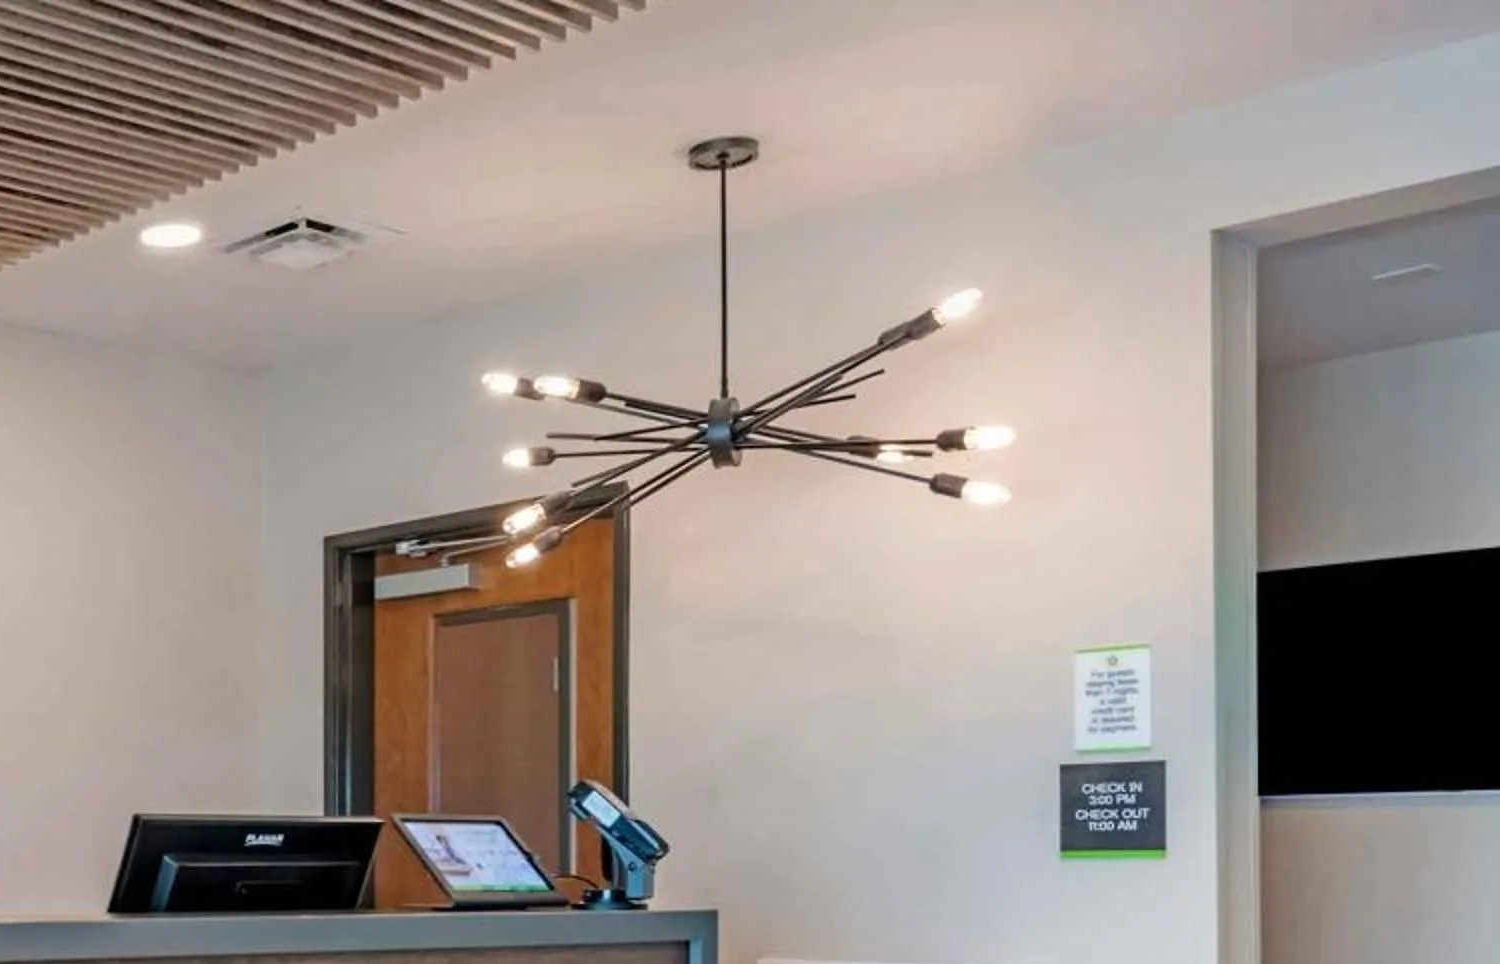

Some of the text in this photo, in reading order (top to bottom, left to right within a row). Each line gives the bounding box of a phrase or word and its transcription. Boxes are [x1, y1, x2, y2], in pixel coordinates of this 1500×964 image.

[1081, 781, 1143, 794] CHECK IN
[1088, 793, 1136, 806] 3:00 PM
[1075, 807, 1151, 821] CHECK OUT
[1088, 820, 1137, 831] 11:00 AM
